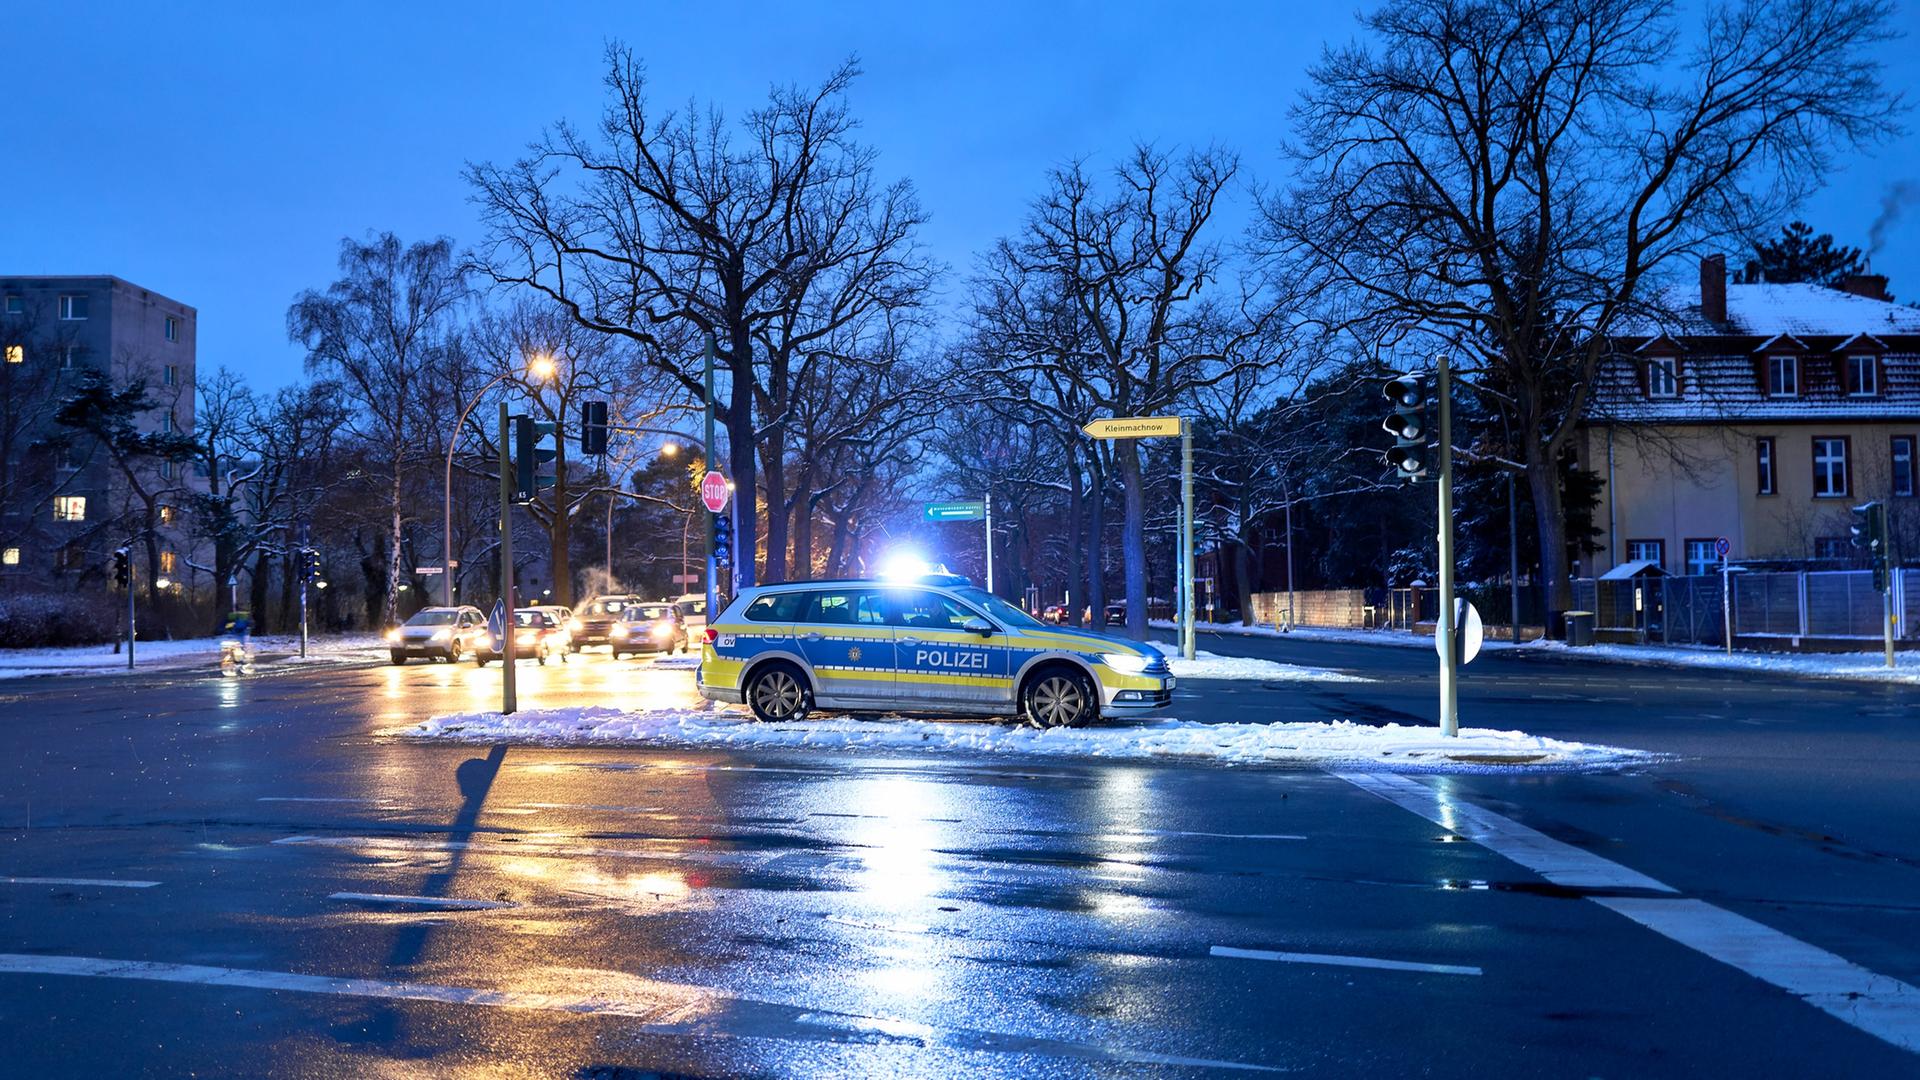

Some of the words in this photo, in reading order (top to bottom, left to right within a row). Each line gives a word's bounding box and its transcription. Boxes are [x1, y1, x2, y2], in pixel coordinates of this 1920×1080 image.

[1105, 424, 1163, 432] Kleinmachnow
[704, 484, 725, 499] STOP
[916, 650, 988, 669] POLIZEI
